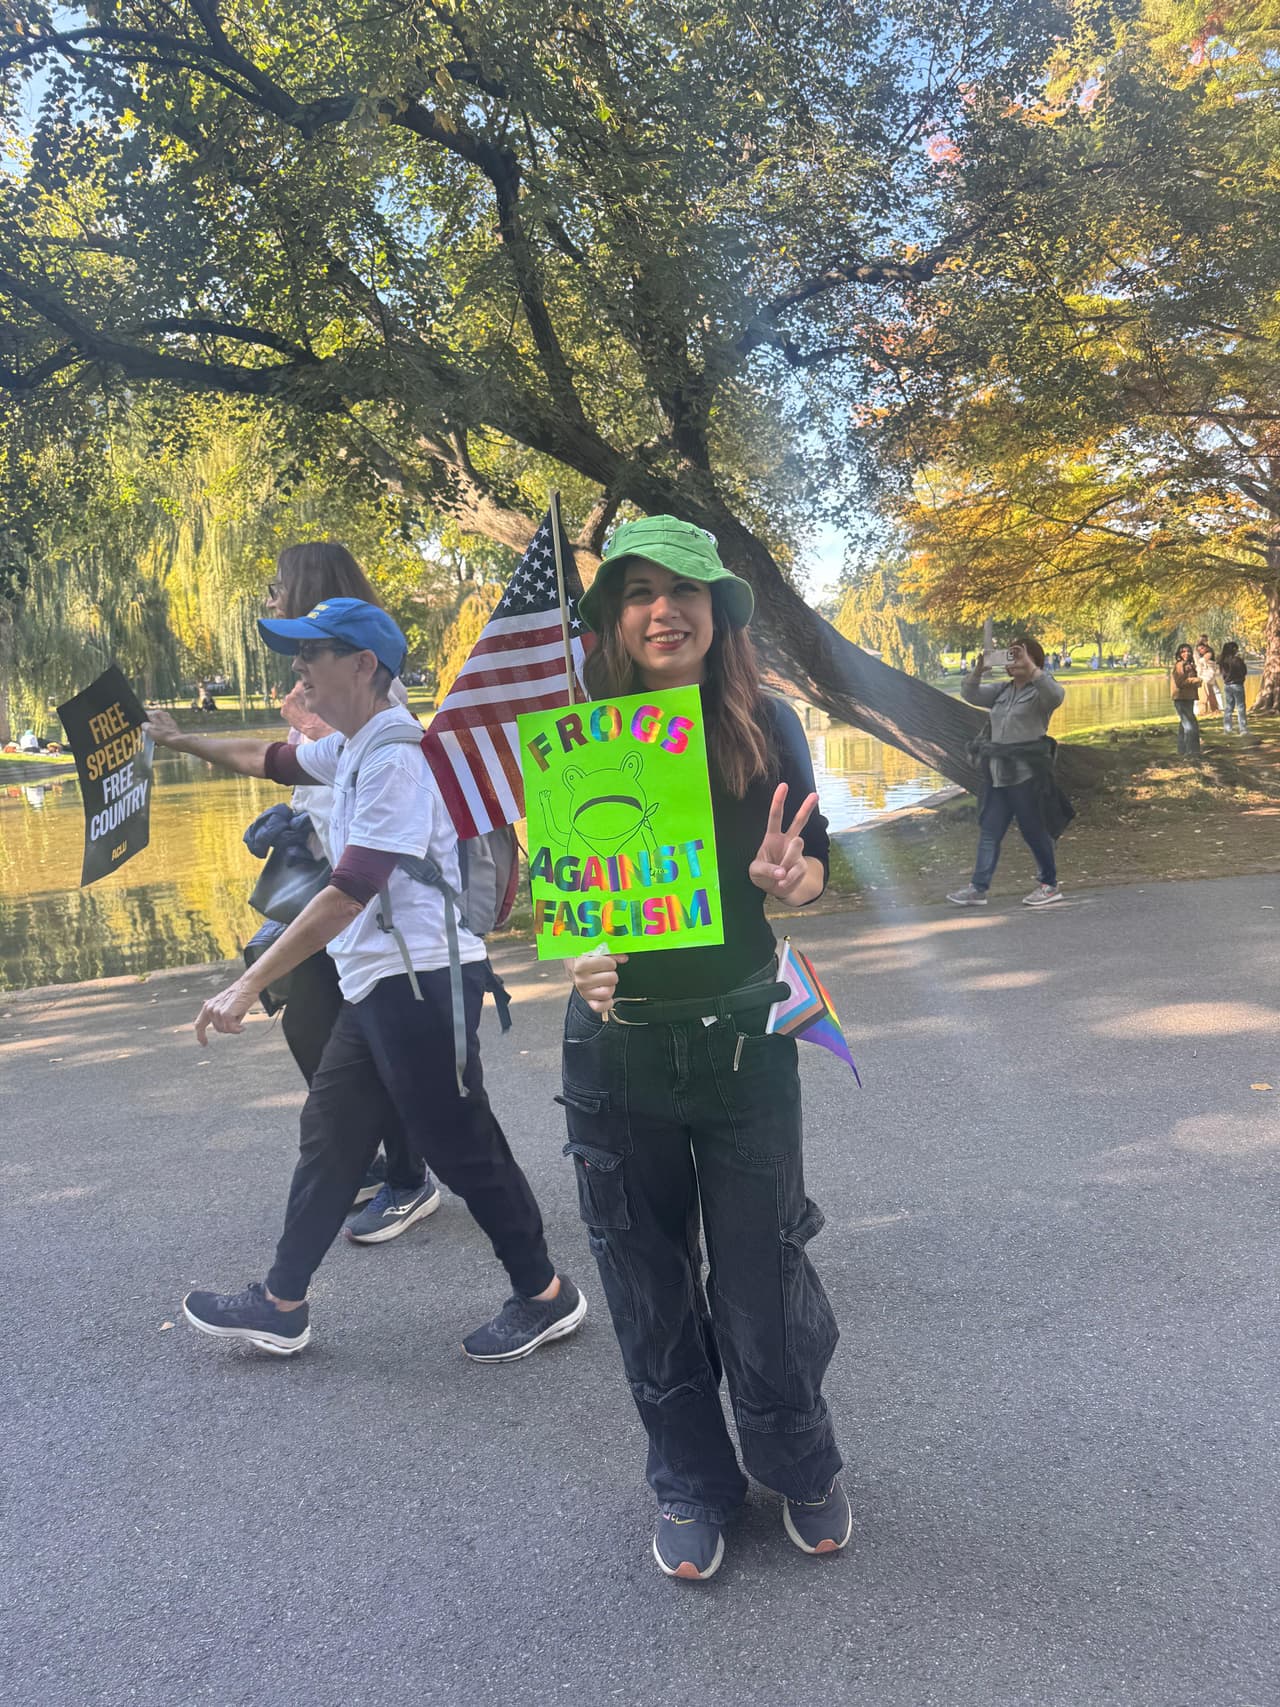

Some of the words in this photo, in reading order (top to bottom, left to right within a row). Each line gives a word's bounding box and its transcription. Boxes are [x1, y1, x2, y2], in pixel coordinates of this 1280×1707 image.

[88, 702, 129, 744] FREE
[526, 704, 695, 773] FROGS
[102, 761, 135, 805] FREE
[90, 778, 149, 841] COUNTRY
[111, 839, 127, 861] ACLU
[530, 839, 704, 893] AGAINST
[534, 888, 713, 938] FASCISM
